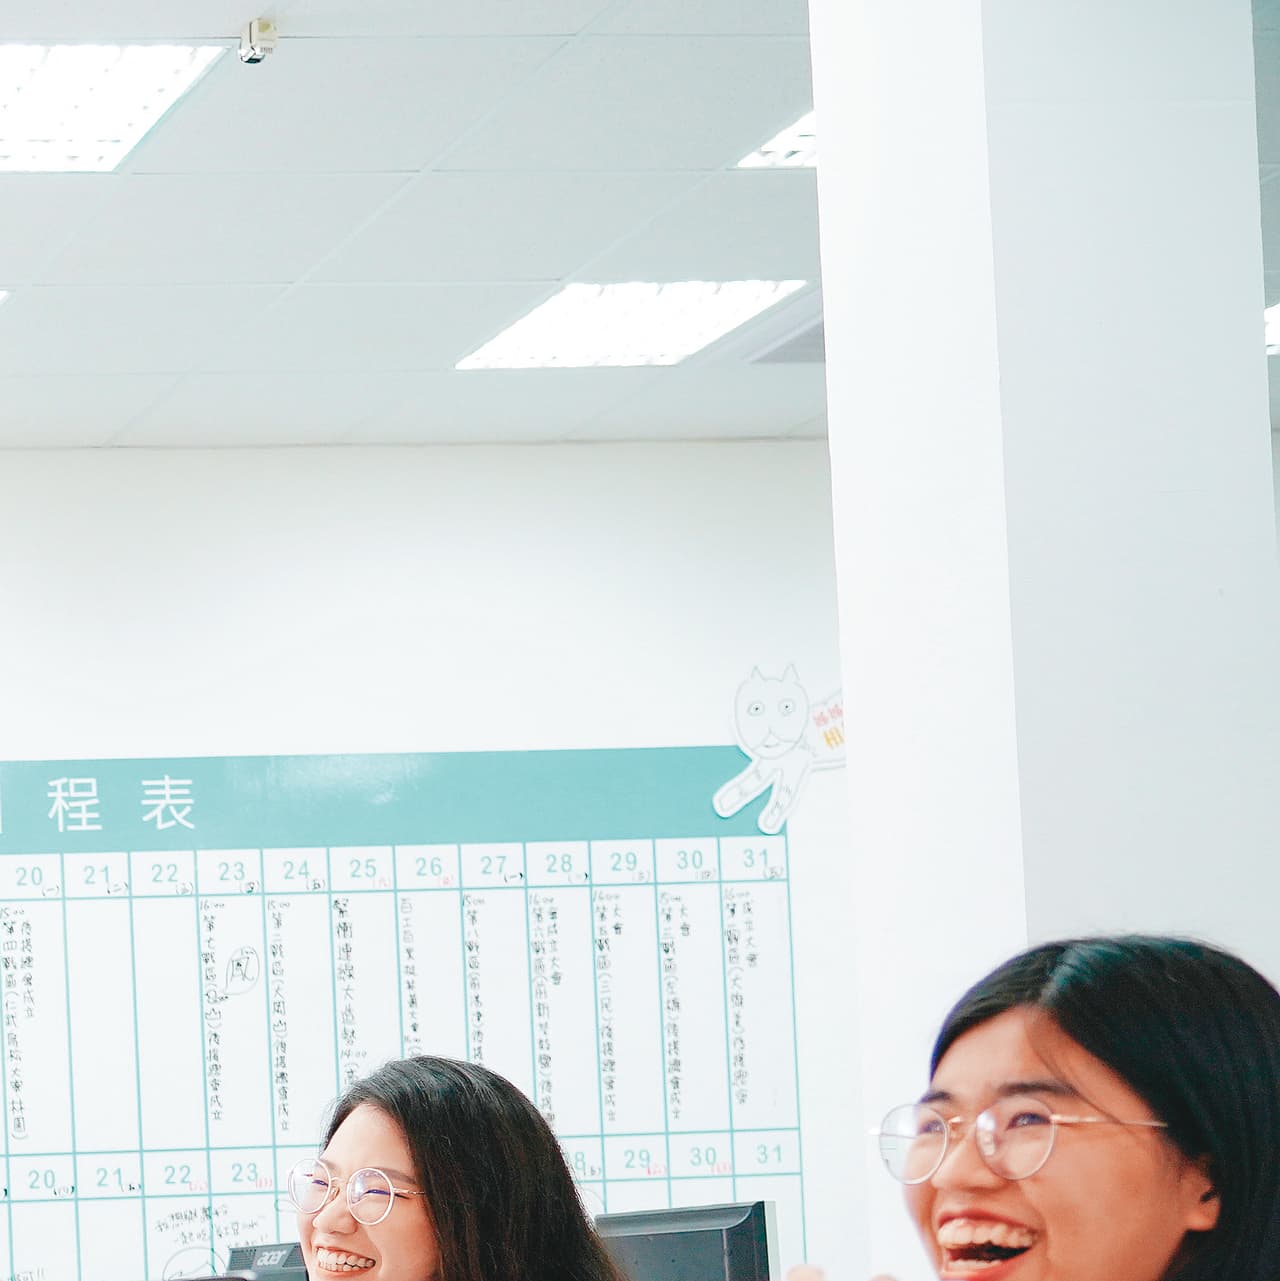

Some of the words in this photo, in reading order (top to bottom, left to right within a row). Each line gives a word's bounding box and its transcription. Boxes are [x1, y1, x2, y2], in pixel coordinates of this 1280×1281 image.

[15, 866, 43, 887] 20
[82, 865, 111, 886] 21
[150, 863, 179, 883] 22
[218, 861, 246, 882] 23
[282, 860, 311, 881] 24
[349, 858, 377, 879] 25
[415, 856, 443, 877] 26
[480, 855, 508, 875] 27
[545, 853, 573, 873] 28
[609, 852, 638, 872] 29
[676, 850, 704, 870] 30
[743, 848, 769, 868] 31
[624, 1149, 651, 1170] 29
[690, 1146, 717, 1167] 30
[757, 1144, 783, 1165] 31
[28, 1168, 57, 1190] 20
[96, 1167, 123, 1189] 21
[164, 1164, 192, 1185] 22
[231, 1162, 259, 1183] 23
